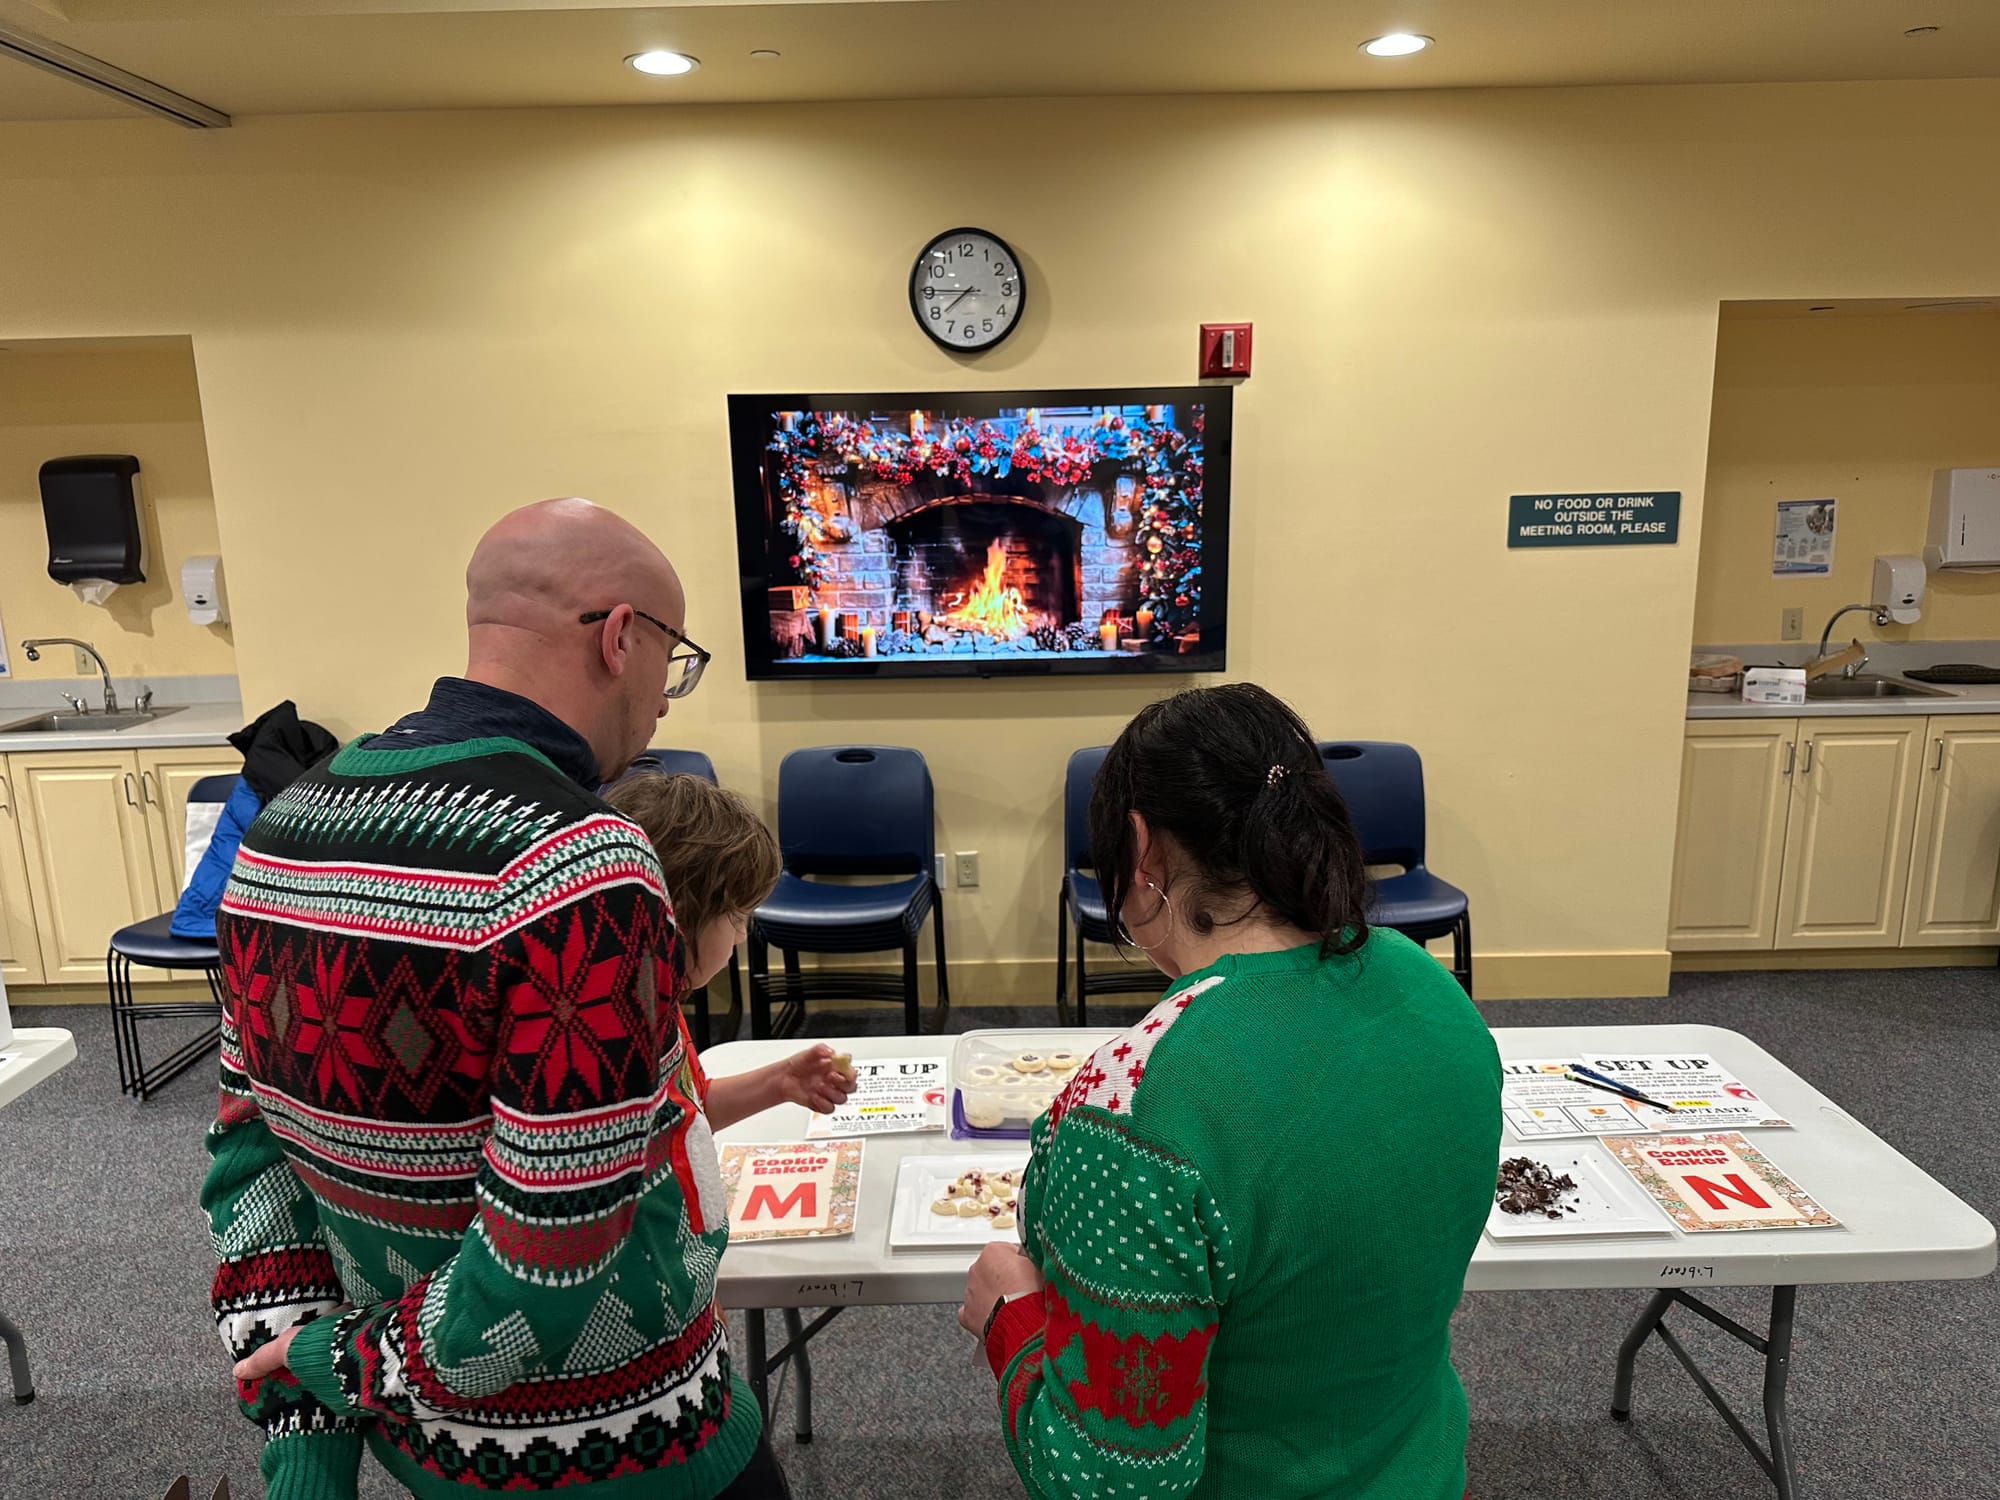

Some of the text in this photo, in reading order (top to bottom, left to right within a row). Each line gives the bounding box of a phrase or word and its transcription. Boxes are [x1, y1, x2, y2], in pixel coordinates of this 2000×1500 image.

[958, 243, 973, 257] 12
[984, 249, 990, 262] 1
[942, 250, 952, 264] 11
[928, 265, 944, 278] 10
[994, 263, 1004, 276] 2
[924, 286, 935, 300] 9
[1002, 282, 1012, 296] 3
[930, 306, 941, 320] 8
[996, 304, 1006, 318] 4
[946, 320, 956, 334] 7
[964, 325, 975, 338] 6
[982, 318, 993, 332] 5
[1534, 497, 1654, 510] NO FOOD OR DRINK
[1554, 510, 1634, 522] OUTSIDE THE
[1520, 522, 1666, 536] MEETING ROOM, PLEASE
[898, 1064, 938, 1075] UP
[1594, 1059, 1710, 1071] SET UP
[832, 1112, 926, 1122] SWAP/TASTE
[1647, 1148, 1726, 1158] Cookie
[752, 1156, 828, 1167] Cookie
[1657, 1158, 1730, 1166] Baker
[753, 1165, 824, 1175] Baker
[1681, 1174, 1773, 1210] N
[740, 1182, 816, 1221] M
[1660, 1266, 1713, 1278] Library
[798, 1281, 863, 1298] Library
